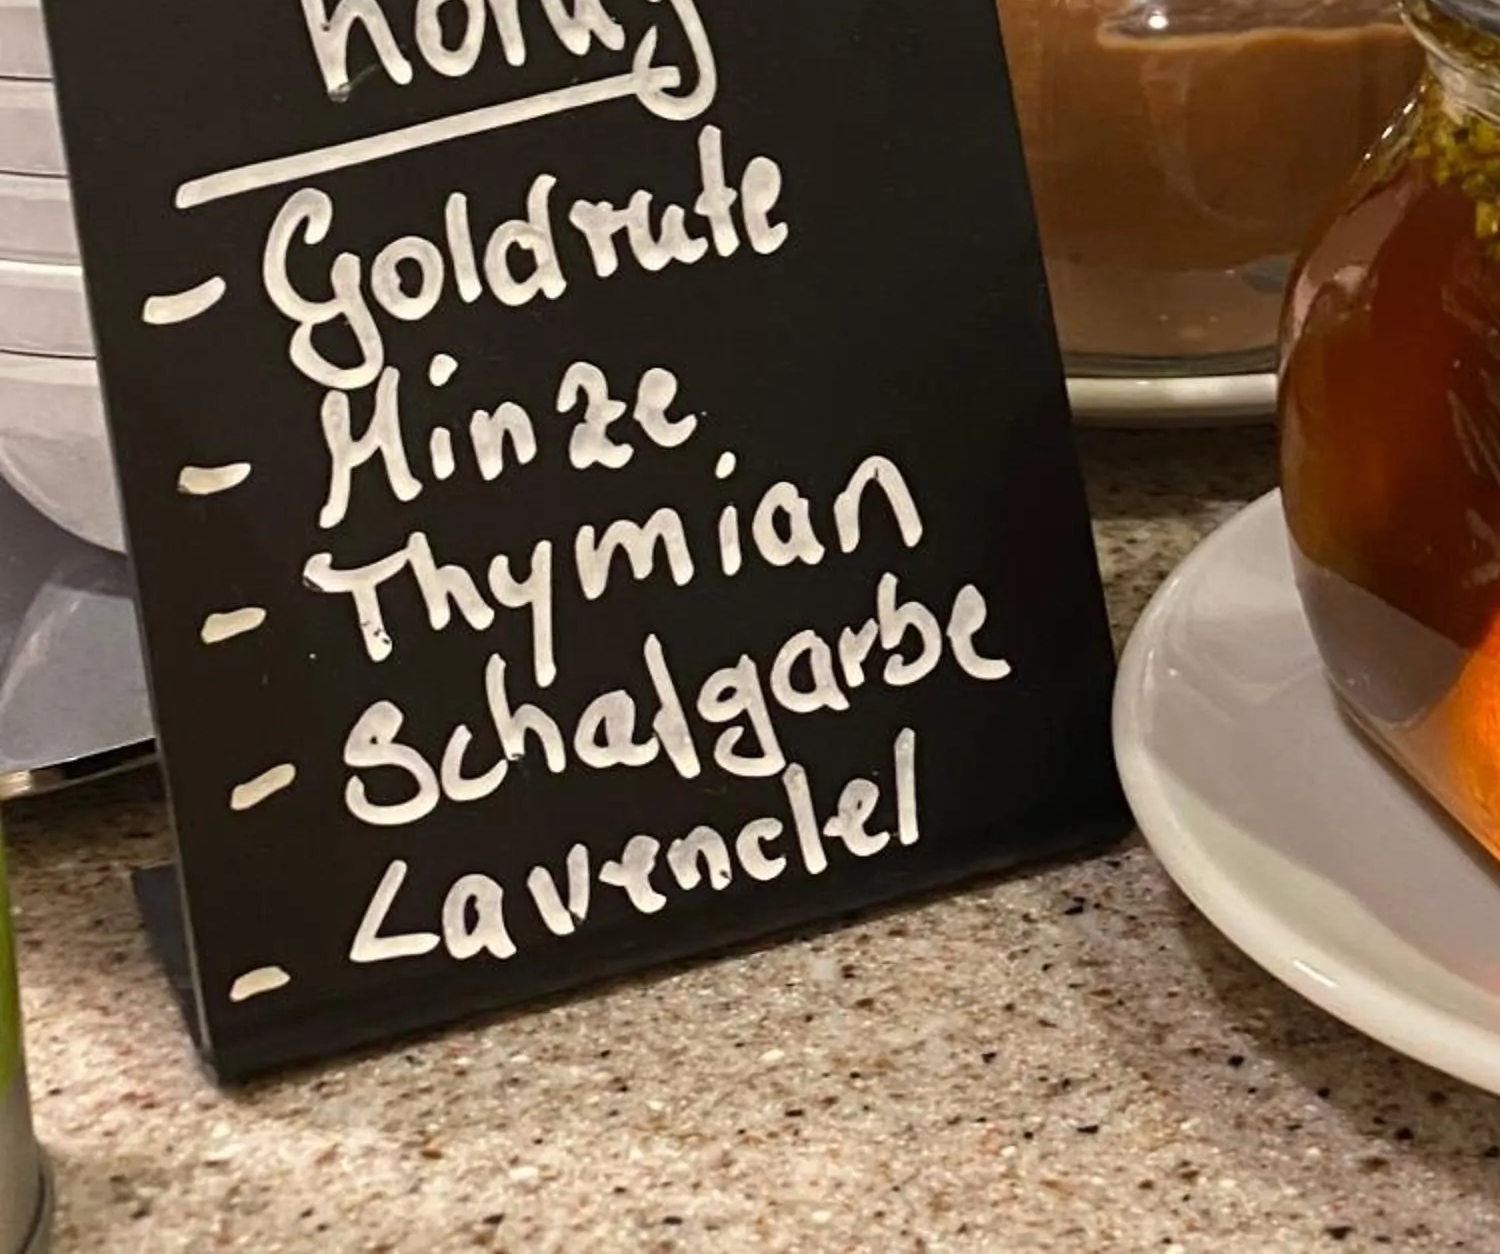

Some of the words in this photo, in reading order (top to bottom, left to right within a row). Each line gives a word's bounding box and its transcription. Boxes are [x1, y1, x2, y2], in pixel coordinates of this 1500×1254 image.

[262, 124, 790, 390] Goldrute
[319, 353, 698, 529] Minze
[302, 451, 923, 688] Thymian
[349, 727, 919, 963] Lavendel
